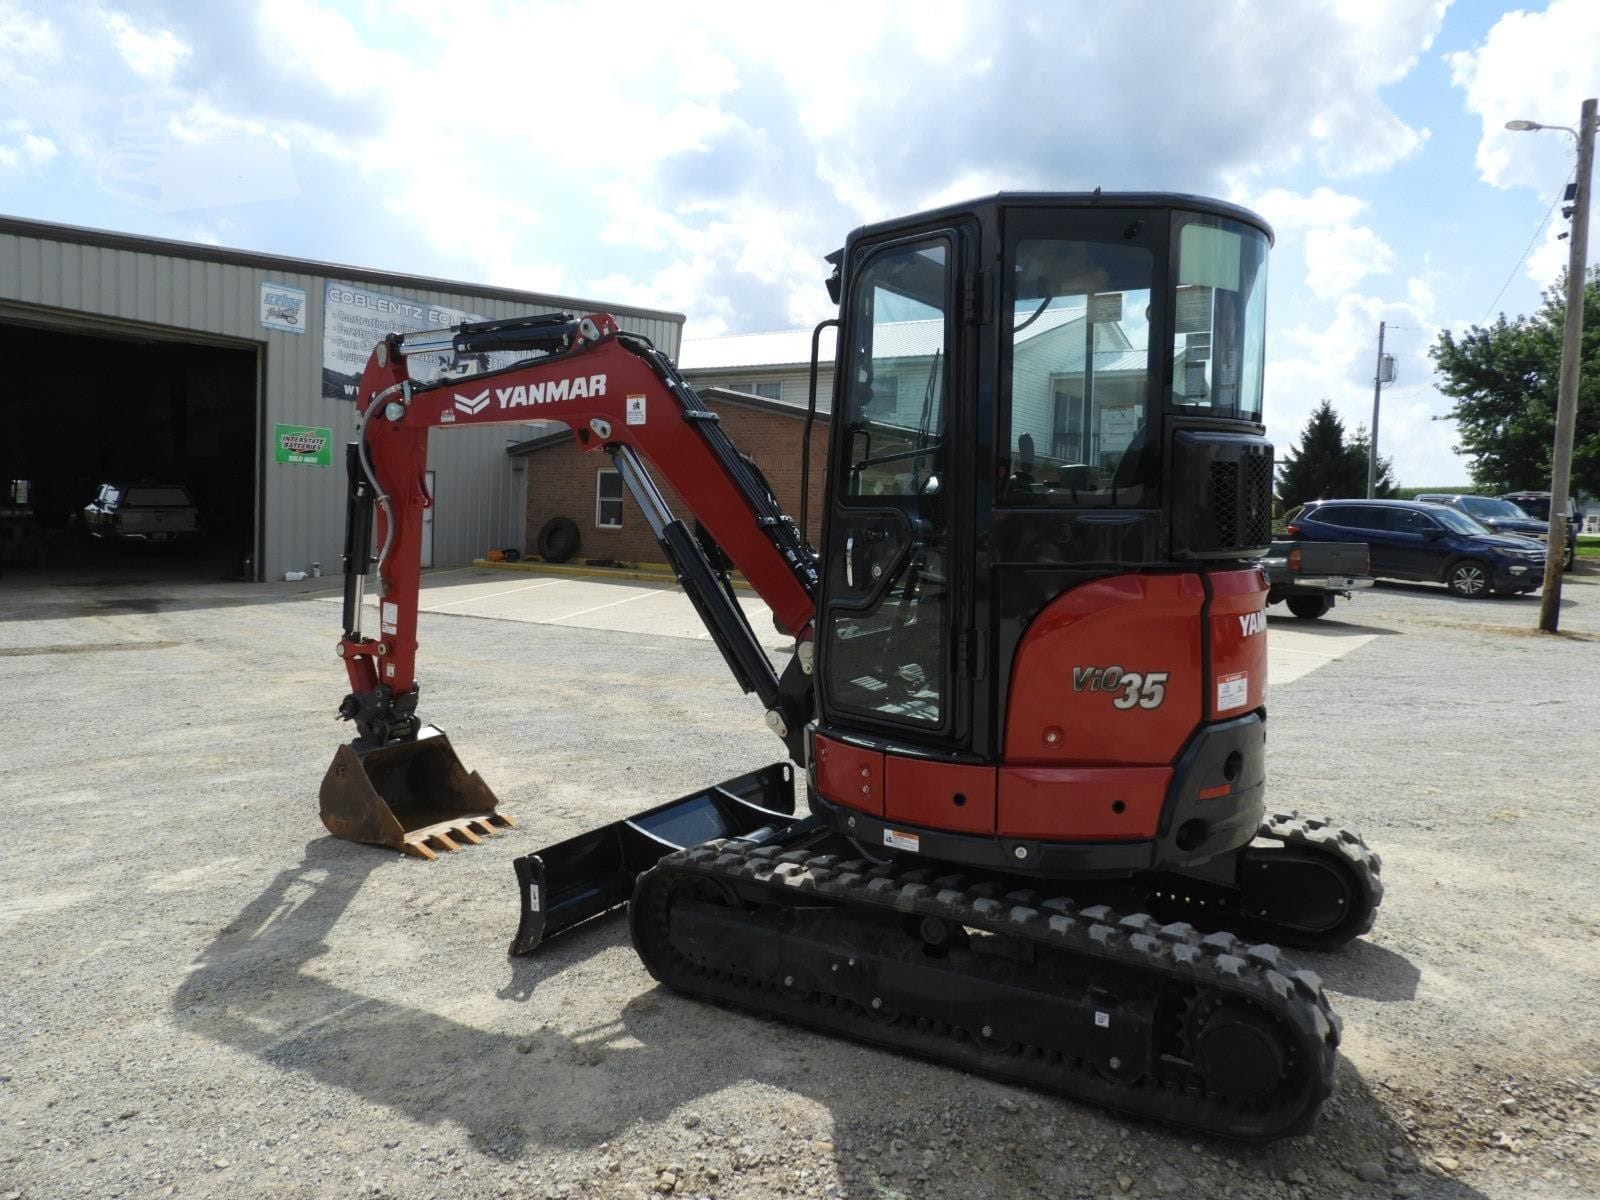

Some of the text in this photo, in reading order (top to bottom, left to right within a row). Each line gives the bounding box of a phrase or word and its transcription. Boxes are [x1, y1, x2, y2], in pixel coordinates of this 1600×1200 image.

[329, 289, 423, 319] COBLENTZ
[495, 374, 607, 409] YANMAR
[282, 434, 324, 445] INTERSTATE
[282, 442, 321, 451] BATTERIES
